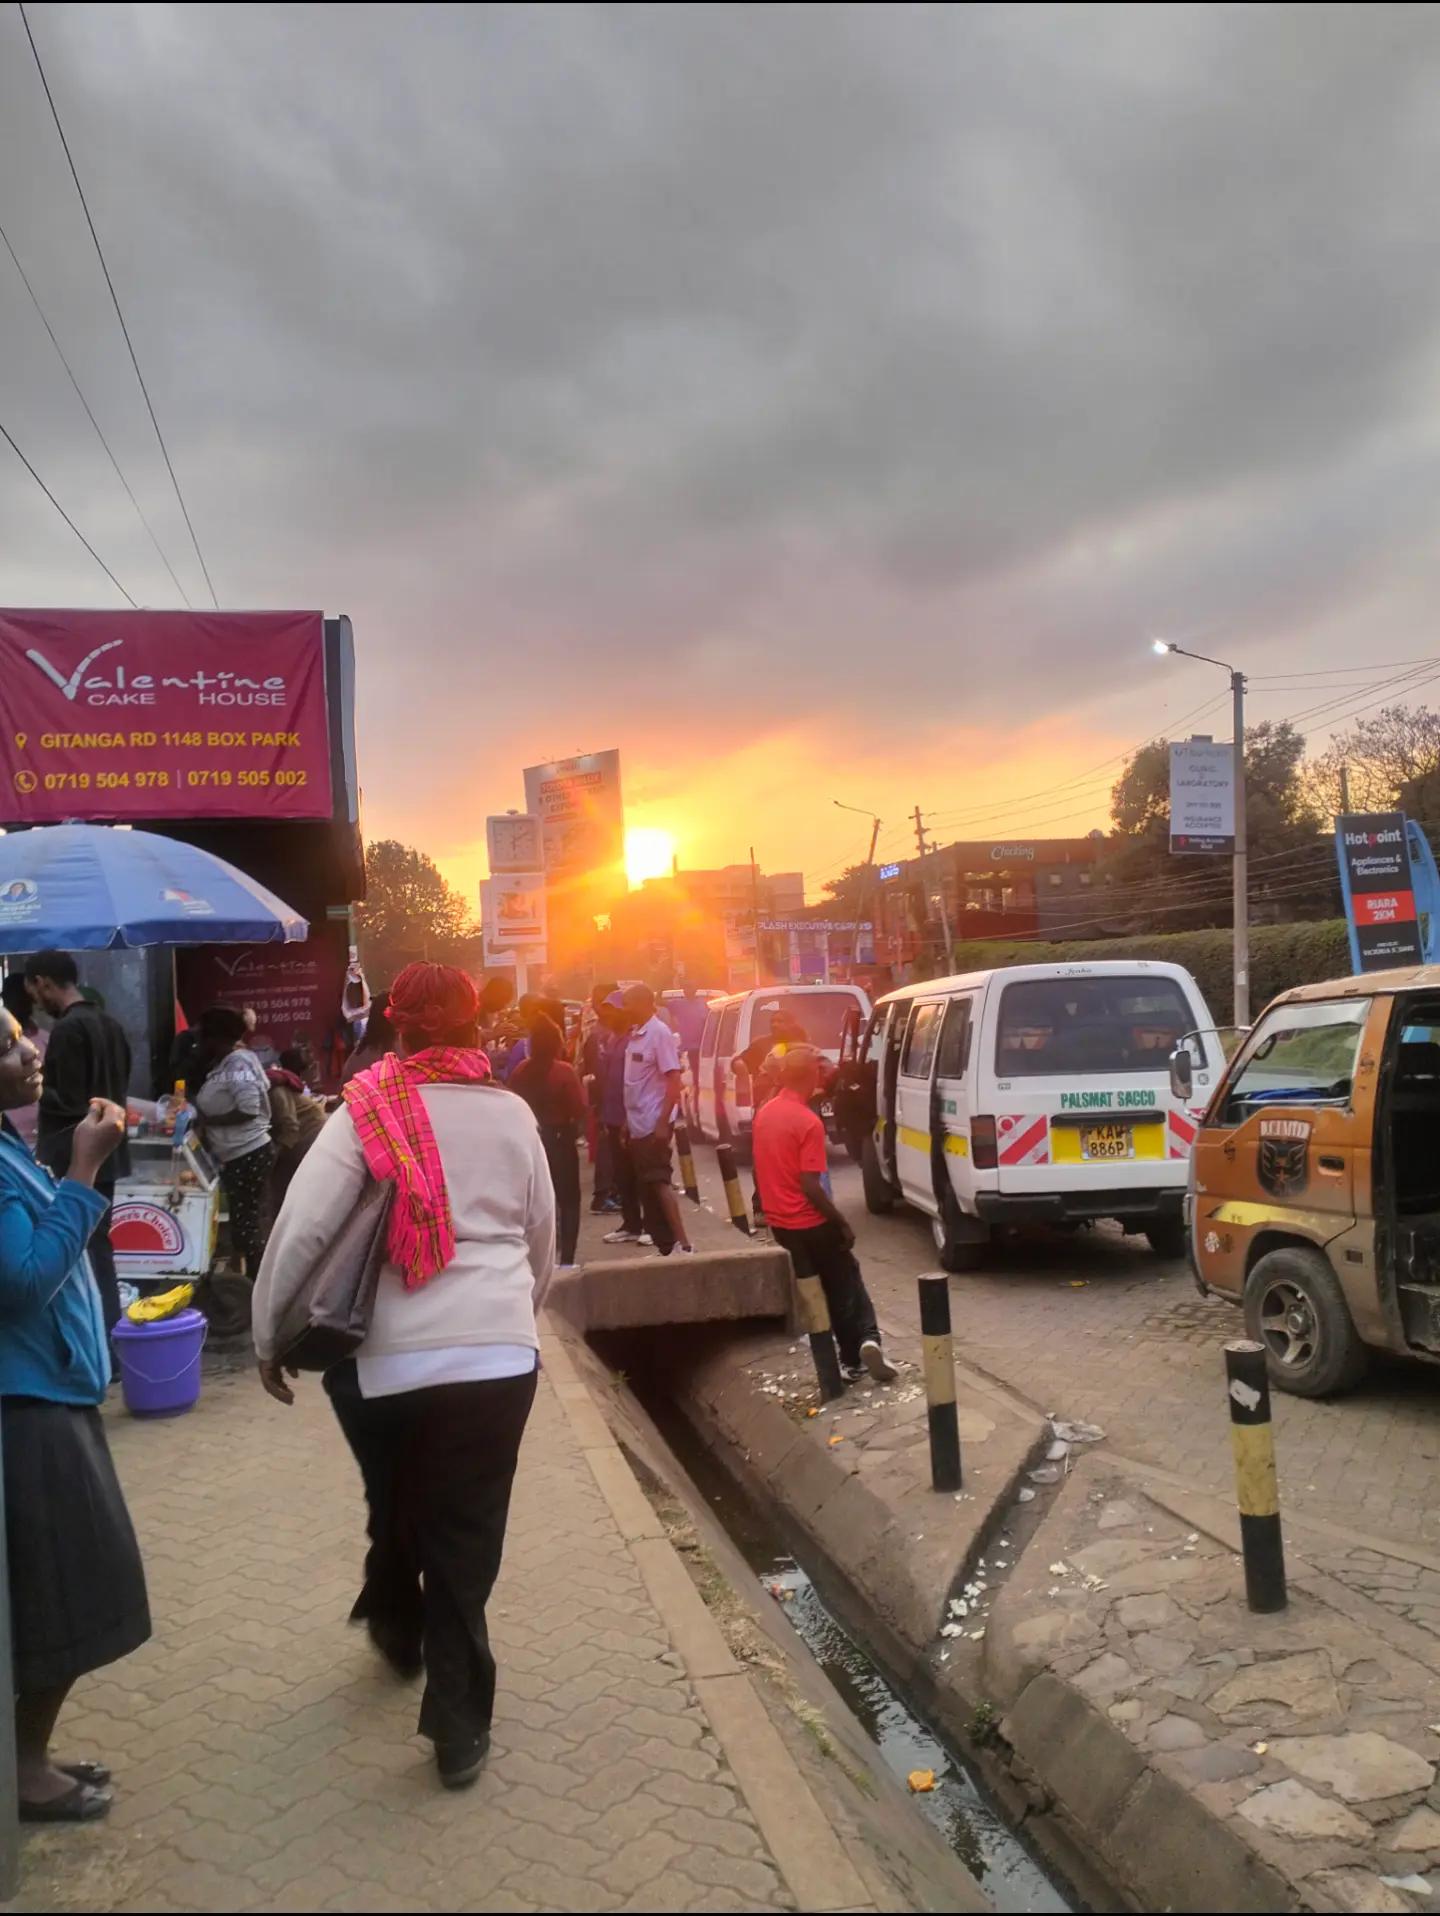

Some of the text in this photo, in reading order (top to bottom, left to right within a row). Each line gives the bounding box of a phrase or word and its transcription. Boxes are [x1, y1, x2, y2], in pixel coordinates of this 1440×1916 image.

[26, 639, 285, 700] Valentine
[87, 691, 287, 706] CAKE HOUSE
[40, 731, 301, 749] GITANGA RD 1148 BOX PARK
[44, 770, 308, 789] 0719 504 978 0719 505 002
[1345, 829, 1402, 848] Hotpoint
[1351, 856, 1394, 867] Appliances
[1356, 865, 1399, 876] Electronics
[1060, 1089, 1156, 1109] PALSMAT SACCO
[1090, 1140, 1125, 1157] 886P
[143, 1209, 173, 1248] Choice
